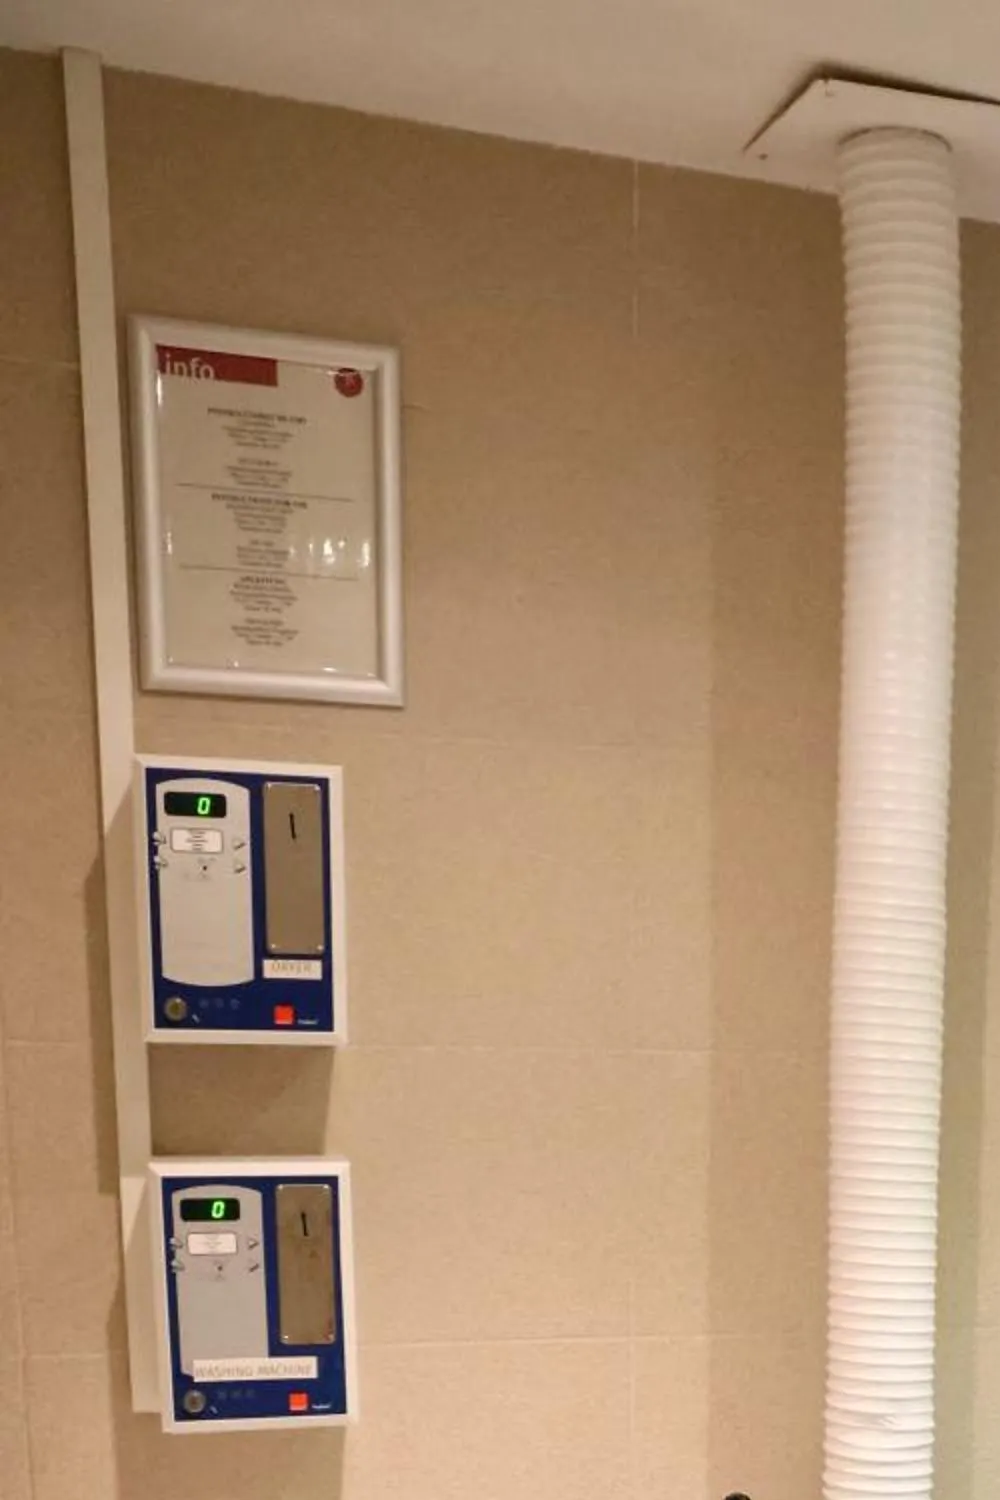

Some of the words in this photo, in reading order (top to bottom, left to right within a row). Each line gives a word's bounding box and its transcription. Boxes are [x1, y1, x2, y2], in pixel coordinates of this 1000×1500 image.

[164, 353, 217, 380] info
[197, 797, 211, 815] 0
[211, 1201, 225, 1219] 0
